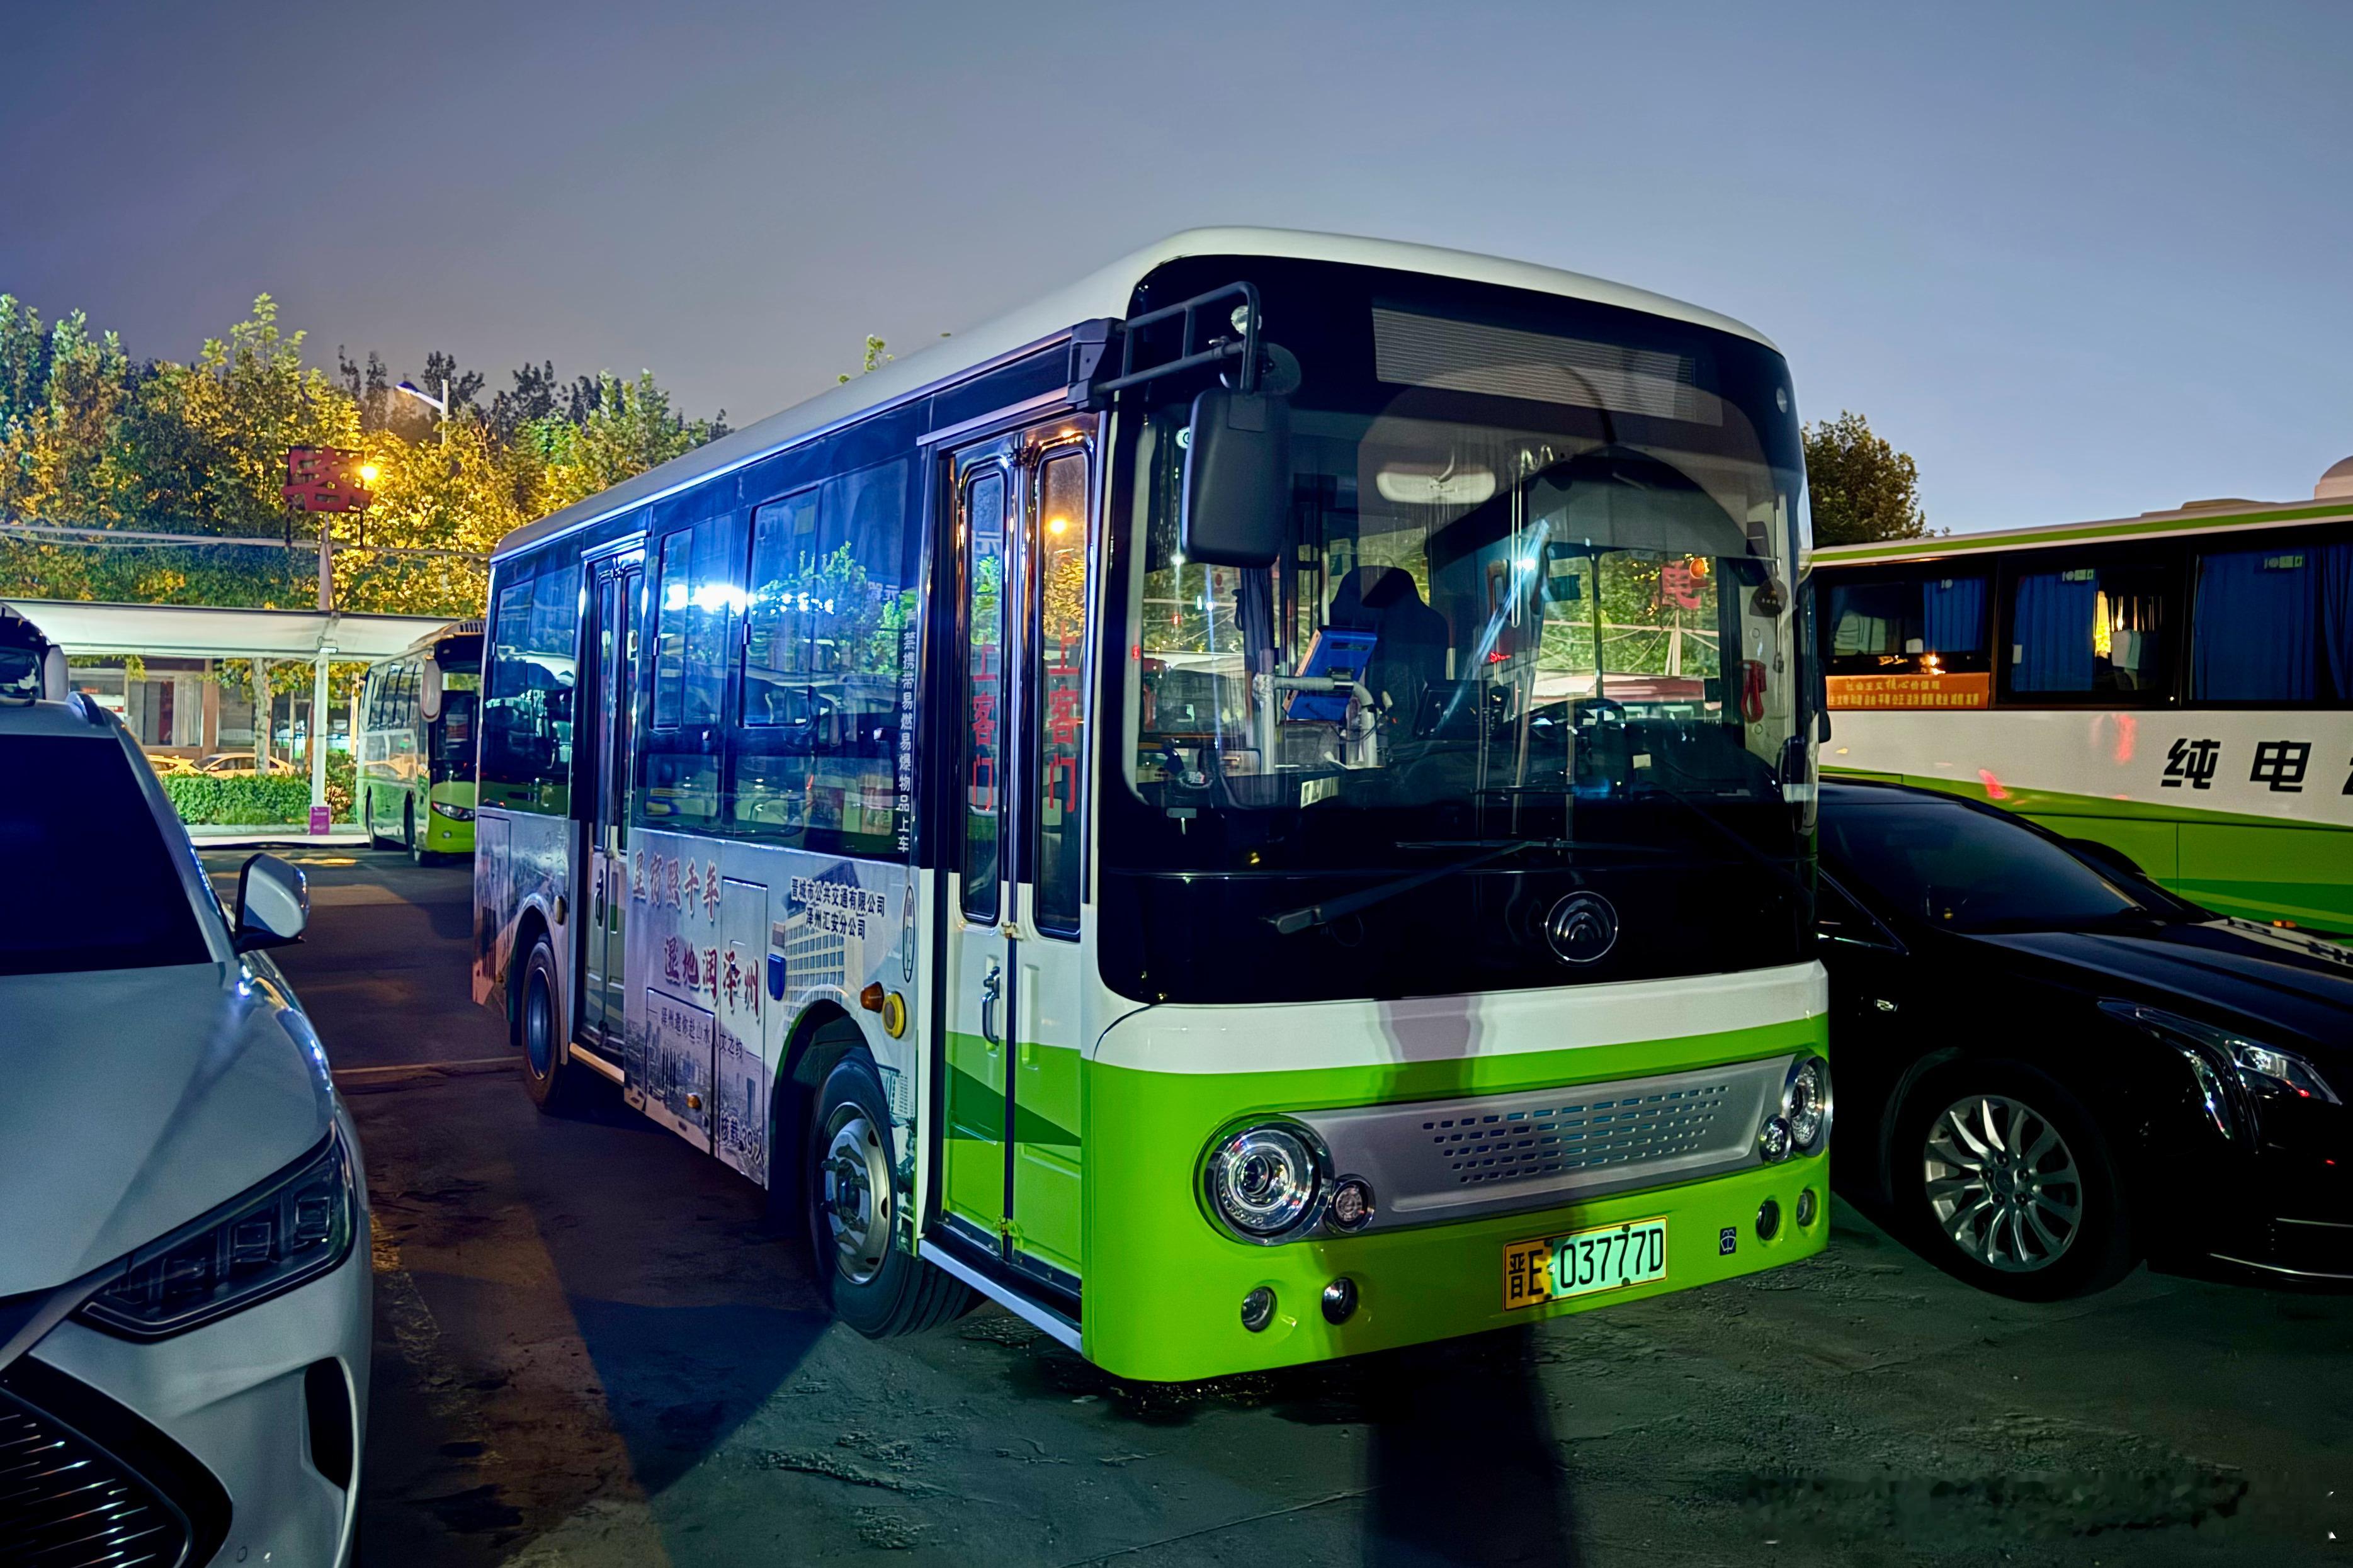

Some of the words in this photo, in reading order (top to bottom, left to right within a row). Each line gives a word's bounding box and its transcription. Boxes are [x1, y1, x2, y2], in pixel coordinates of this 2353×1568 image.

[972, 633, 996, 806] 上客门
[1048, 619, 1079, 813] 上客门
[2161, 738, 2353, 795] 纯电
[633, 850, 720, 922] 星宿照千年
[791, 877, 885, 917] 晋城市公共交通有限公司
[806, 906, 865, 940] 泽州汇安分公司
[665, 937, 759, 1018] 湿地润泽州
